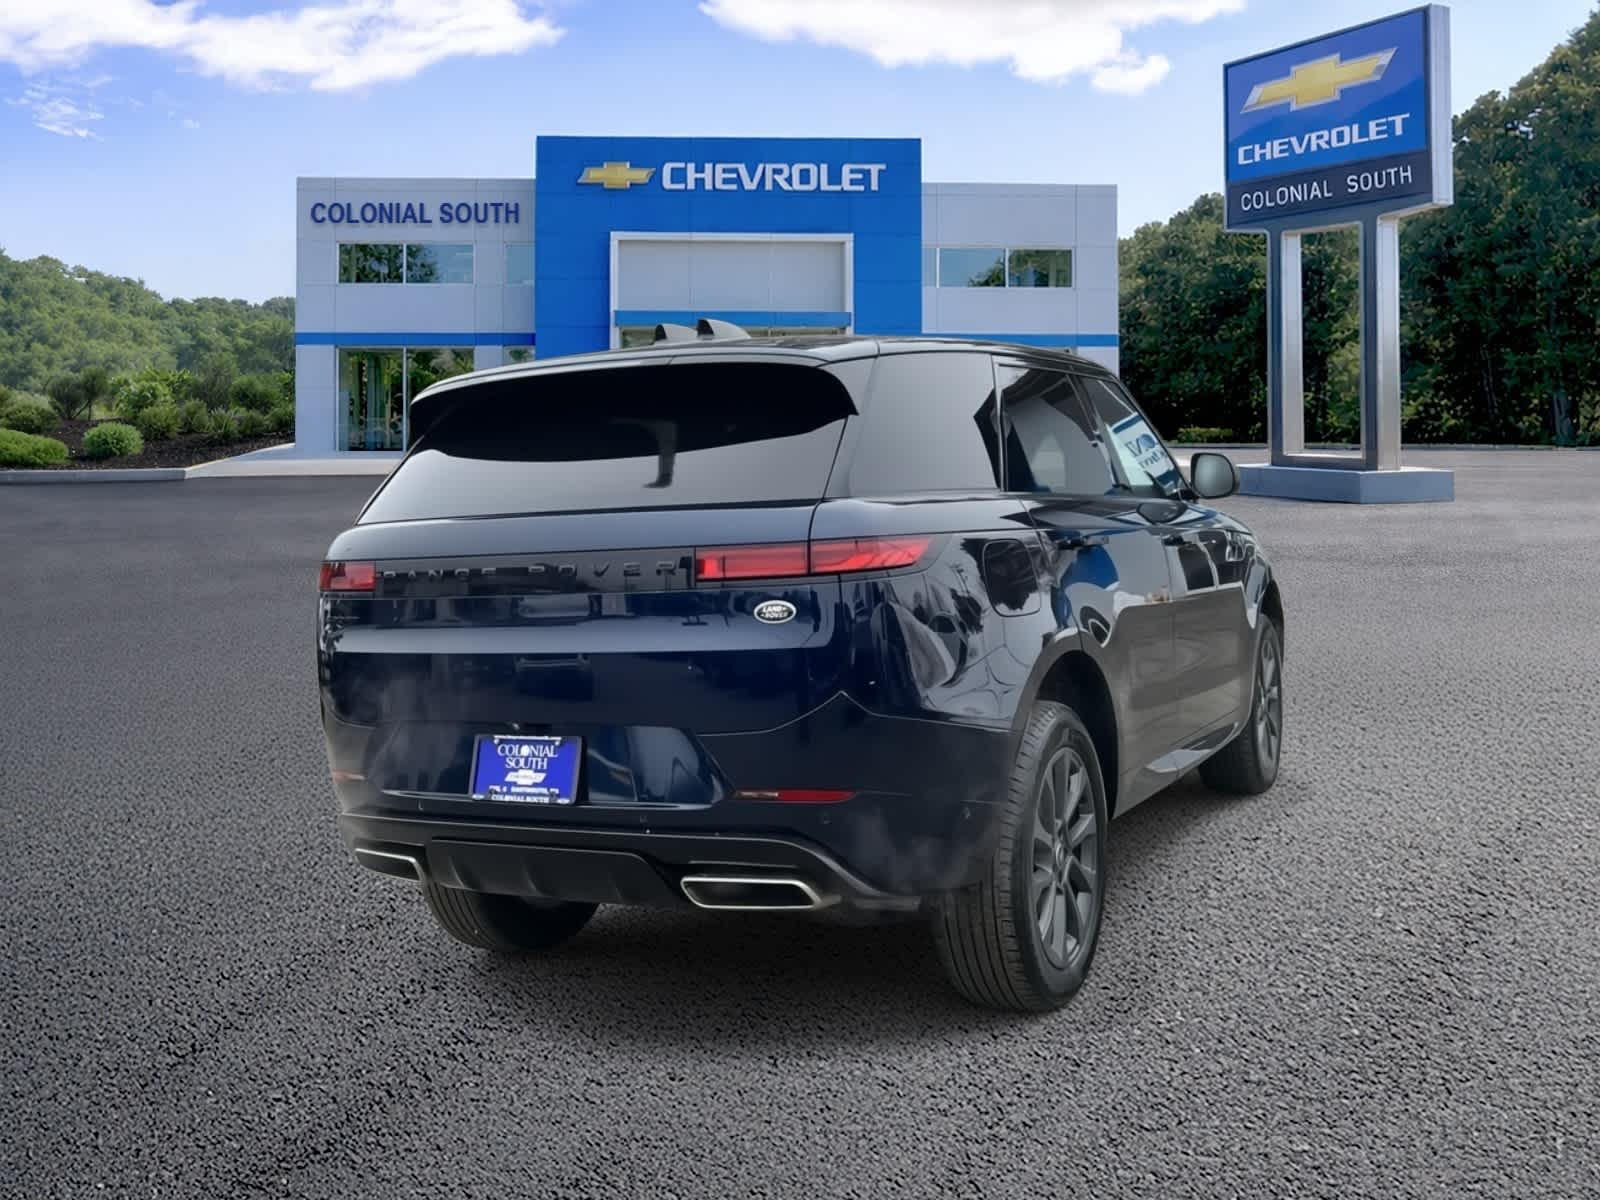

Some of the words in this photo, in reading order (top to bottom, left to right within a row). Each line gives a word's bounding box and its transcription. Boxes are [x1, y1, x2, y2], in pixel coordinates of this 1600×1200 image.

[1237, 113, 1410, 165] CHEVROLET
[661, 162, 887, 193] CHEVROLET
[1241, 180, 1333, 211] COLONIAL
[1346, 165, 1412, 194] SOUTH
[310, 202, 432, 224] COLONIAL
[439, 202, 520, 224] SOUTH
[498, 744, 559, 758] COLONIAL
[505, 757, 548, 770] SOUTH
